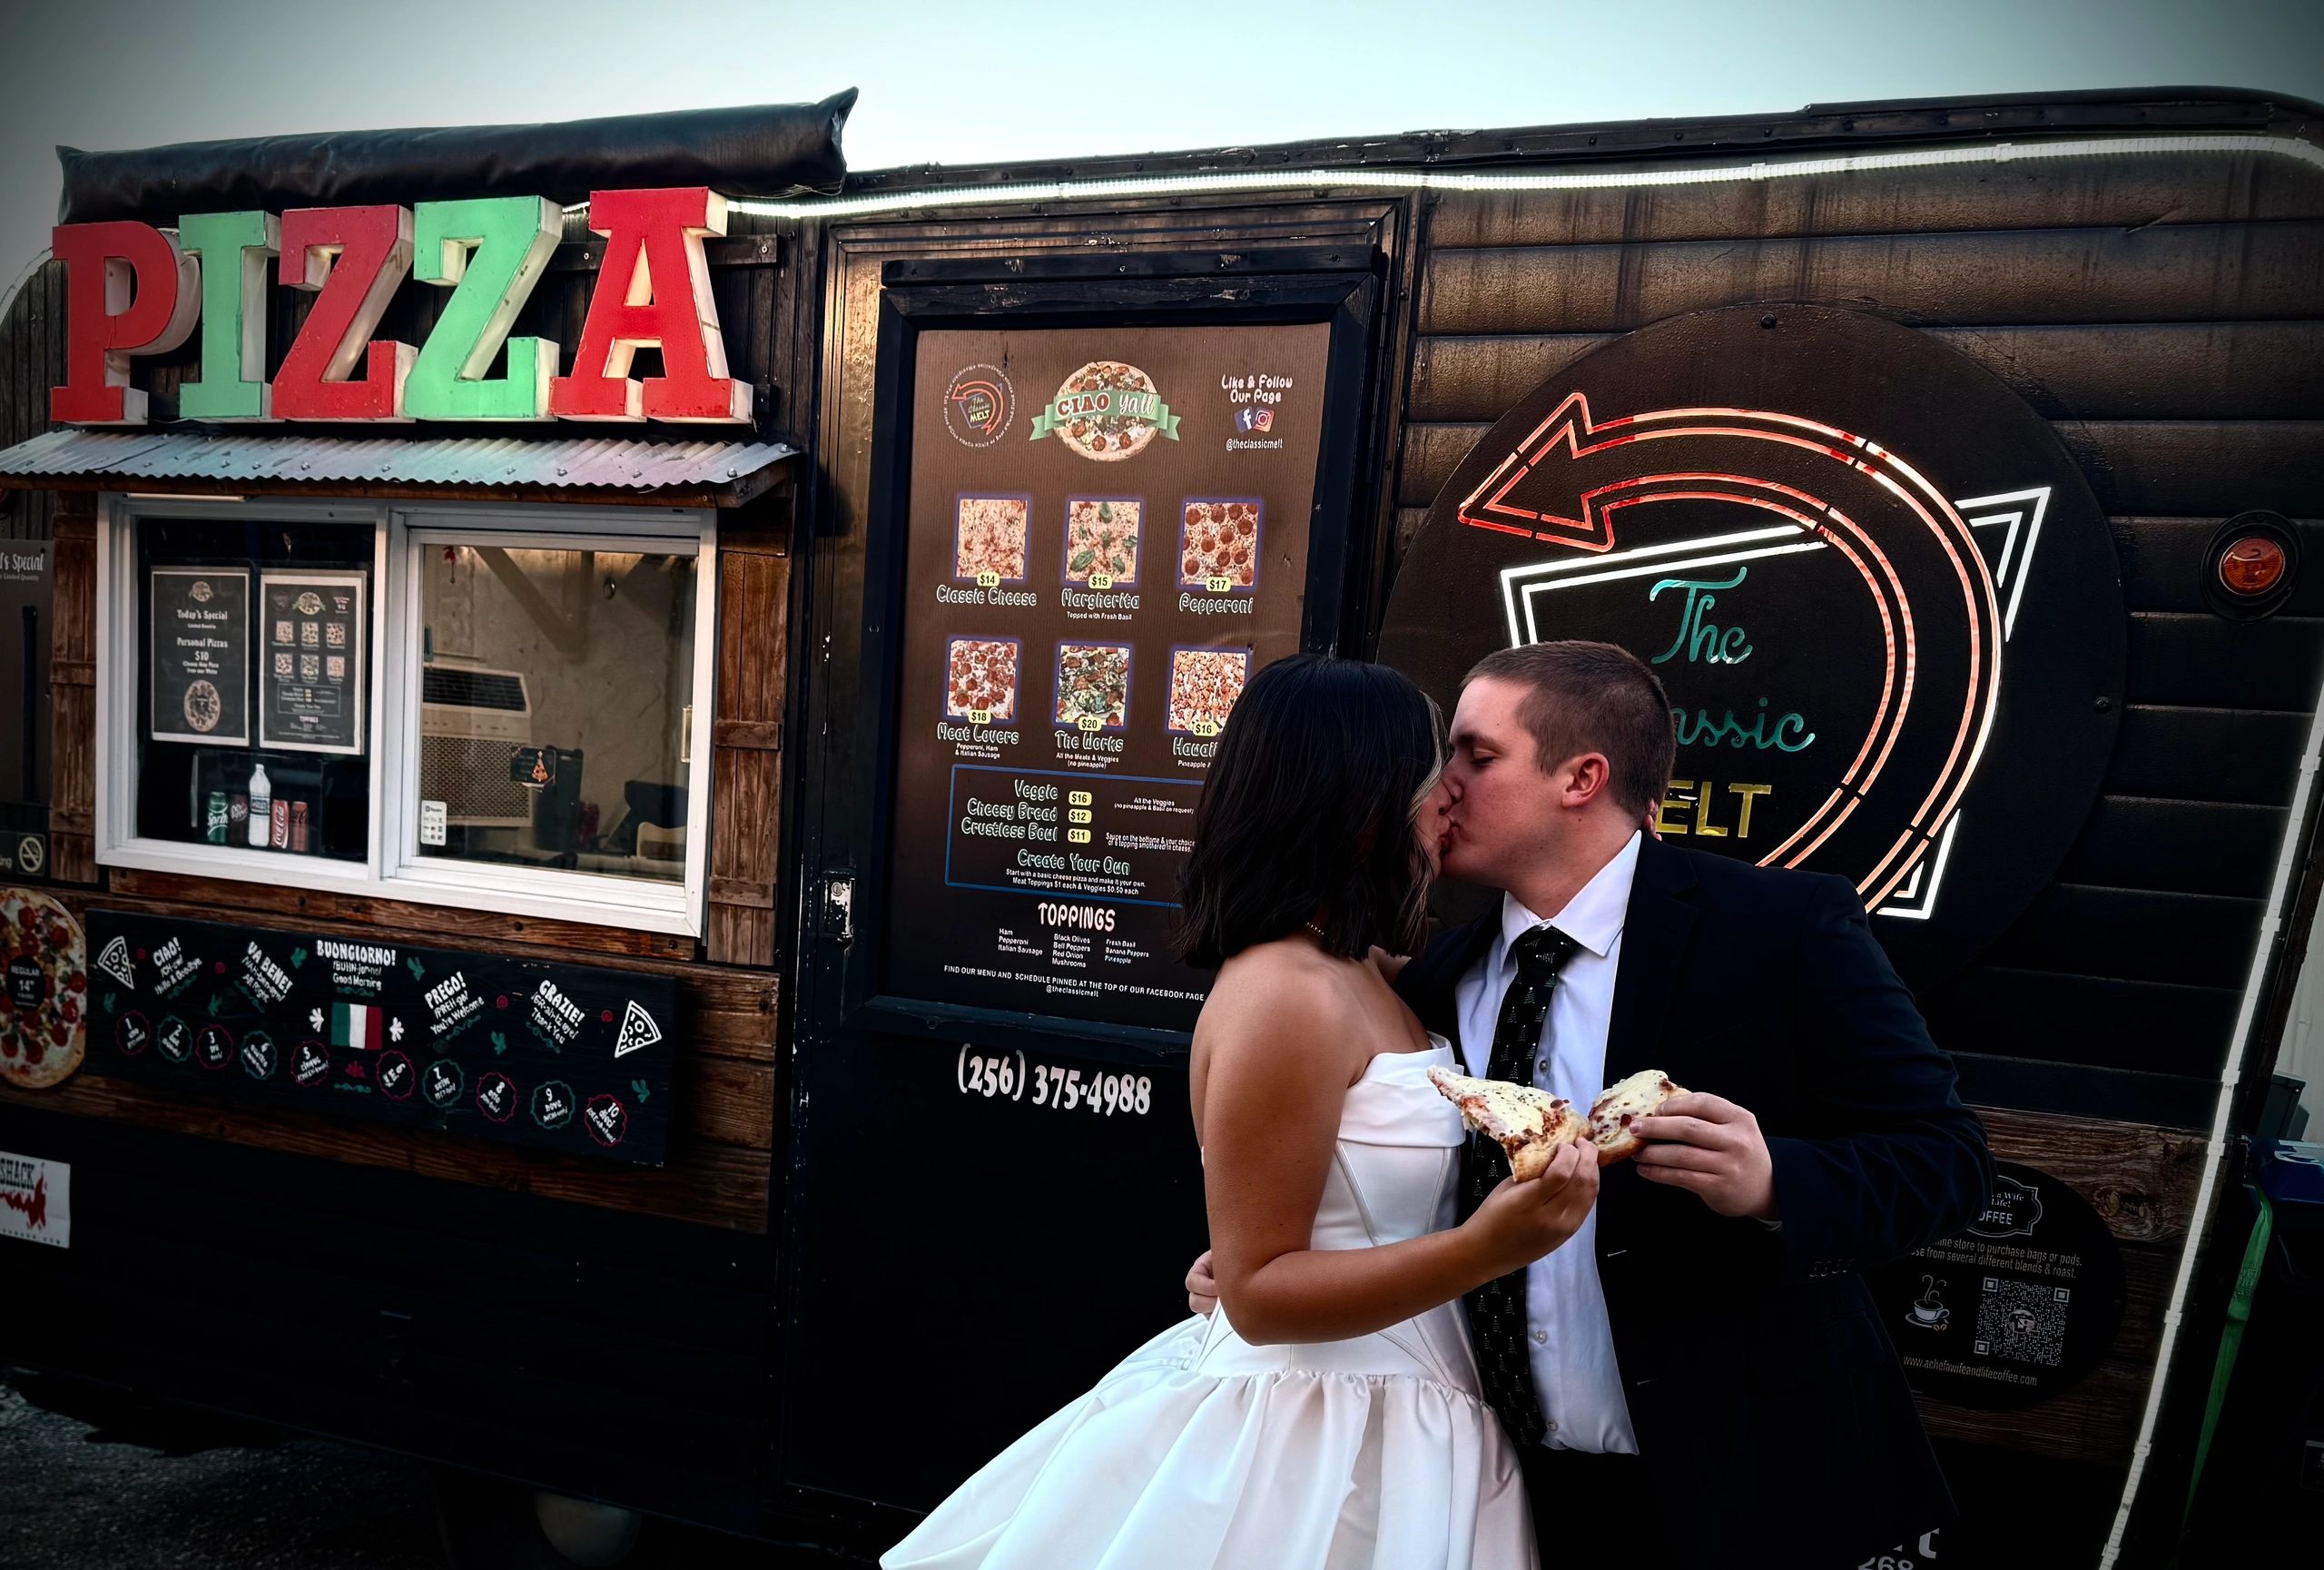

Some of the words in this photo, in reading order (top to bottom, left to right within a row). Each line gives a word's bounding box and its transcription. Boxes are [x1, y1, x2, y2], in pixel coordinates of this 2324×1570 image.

[51, 187, 753, 425] PIZZA
[1221, 373, 1245, 390] Like
[1246, 375, 1256, 389] &
[1258, 373, 1293, 389] Follow
[1230, 389, 1251, 403] Our
[1254, 388, 1282, 405] Page
[1056, 392, 1111, 418] CIAO
[970, 410, 990, 422] MELT
[1226, 438, 1283, 451] @theclassicmelt
[12, 553, 44, 573] Special
[980, 574, 996, 585] $14
[1091, 576, 1108, 587] $15
[1209, 579, 1226, 590] $17
[936, 584, 986, 605] Classic
[988, 586, 1037, 607] Cheese
[1061, 588, 1140, 610] Margherita
[1179, 592, 1255, 616] Pepperoni
[203, 610, 228, 620] Special
[1650, 566, 1754, 665] The
[971, 711, 987, 721] $18
[1081, 719, 1098, 729] $20
[1196, 724, 1212, 734] $16
[1671, 696, 1816, 752] assic
[937, 722, 970, 742] Meat
[973, 724, 1019, 745] Lovers
[1054, 729, 1080, 749] The
[1083, 731, 1125, 752] Works
[956, 743, 985, 753] Pepperoni,
[1078, 761, 1107, 769] pineapple)
[1098, 755, 1119, 764] Veggies
[1177, 759, 1206, 768] Pineapple
[1014, 779, 1059, 802] Veggie
[1071, 793, 1088, 804] $16
[967, 797, 1015, 821] Cheesy
[1018, 801, 1058, 822] Bread
[1070, 812, 1087, 821] $12
[1656, 780, 1772, 838] ELT
[961, 816, 1026, 838] Crustless
[1028, 822, 1059, 842] Bowl
[1070, 831, 1086, 840] $11
[1018, 848, 1065, 870] Create
[1069, 853, 1100, 873] Your
[1103, 856, 1130, 875] Own
[1006, 868, 1020, 877] Start
[1020, 870, 1032, 878] with
[1037, 872, 1052, 880] basic
[1052, 874, 1072, 882] cheese
[1072, 875, 1088, 884] pizza
[1099, 877, 1114, 885] make
[1119, 880, 1133, 888] your
[1028, 878, 1053, 889] Toppings
[1062, 882, 1077, 890] each
[1083, 883, 1107, 893] Veggies
[1107, 886, 1124, 894] $0.50
[1124, 887, 1139, 895] each
[1038, 902, 1116, 933] TOPPINGS
[999, 928, 1013, 936] Ham
[1053, 933, 1070, 943] Black
[1071, 936, 1091, 944] Olives
[999, 935, 1029, 945] Pepperoni
[1053, 942, 1065, 950] Bell
[1066, 943, 1091, 953] Peppers
[1106, 938, 1122, 947] Fresh
[1122, 940, 1137, 948] Basil
[153, 936, 181, 966] CIAO!
[316, 939, 397, 966] BUONGIORNO!
[998, 944, 1017, 953] Italian
[1017, 945, 1043, 956] Sausage
[1052, 950, 1065, 959] Red
[1065, 952, 1084, 960] Onion
[1105, 946, 1127, 955] Banana
[1127, 949, 1150, 958] Peppers
[1051, 958, 1087, 968] Mushrooms
[1104, 954, 1132, 964] Pineapple
[10, 964, 41, 977] REGULAR
[247, 941, 263, 963] VA
[261, 956, 293, 993] BENE!
[170, 973, 177, 984] &
[332, 972, 352, 985] Good
[353, 974, 382, 992] Morning
[944, 964, 960, 973] FIND
[960, 967, 976, 975] OUR
[977, 969, 997, 977] MENU
[998, 971, 1012, 979] AND
[1015, 973, 1050, 983] SCHEDULE
[1052, 977, 1078, 987] PINNED
[1089, 981, 1103, 990] THE
[1104, 982, 1118, 992] TOP
[1129, 985, 1145, 994] OUR
[1146, 987, 1184, 999] FACEBOOK
[424, 971, 467, 1009] PREGO!
[1046, 984, 1098, 998] @theclassicmelt
[538, 980, 586, 1027] GRAZIE!
[430, 1016, 455, 1034] You're
[450, 995, 485, 1021] Welcome
[124, 1018, 133, 1030] 1
[531, 1007, 552, 1032] Thank
[553, 1025, 566, 1044] You
[208, 1031, 216, 1044] 3
[302, 1045, 311, 1061] 5
[395, 1062, 407, 1075] 6
[432, 1066, 443, 1081] 7
[958, 1043, 1026, 1101] (256)
[1031, 1064, 1151, 1116] 375-4988
[495, 1081, 506, 1094] 8
[545, 1088, 554, 1101] 9
[608, 1101, 620, 1119] 10
[2004, 1191, 2025, 1202] Wife
[1978, 1210, 2014, 1226] OFFEE
[1954, 1238, 1975, 1251] store
[1976, 1242, 1986, 1253] to
[1986, 1242, 2026, 1260] purchase
[2026, 1247, 2048, 1264] bags
[2049, 1252, 2059, 1262] or
[2060, 1253, 2083, 1268] pods.
[1926, 1248, 1946, 1260] from
[1946, 1251, 1977, 1265] several
[1977, 1253, 2014, 1270] different
[2014, 1259, 2043, 1275] blends
[2043, 1263, 2051, 1275] &
[2052, 1266, 2077, 1279] roast.
